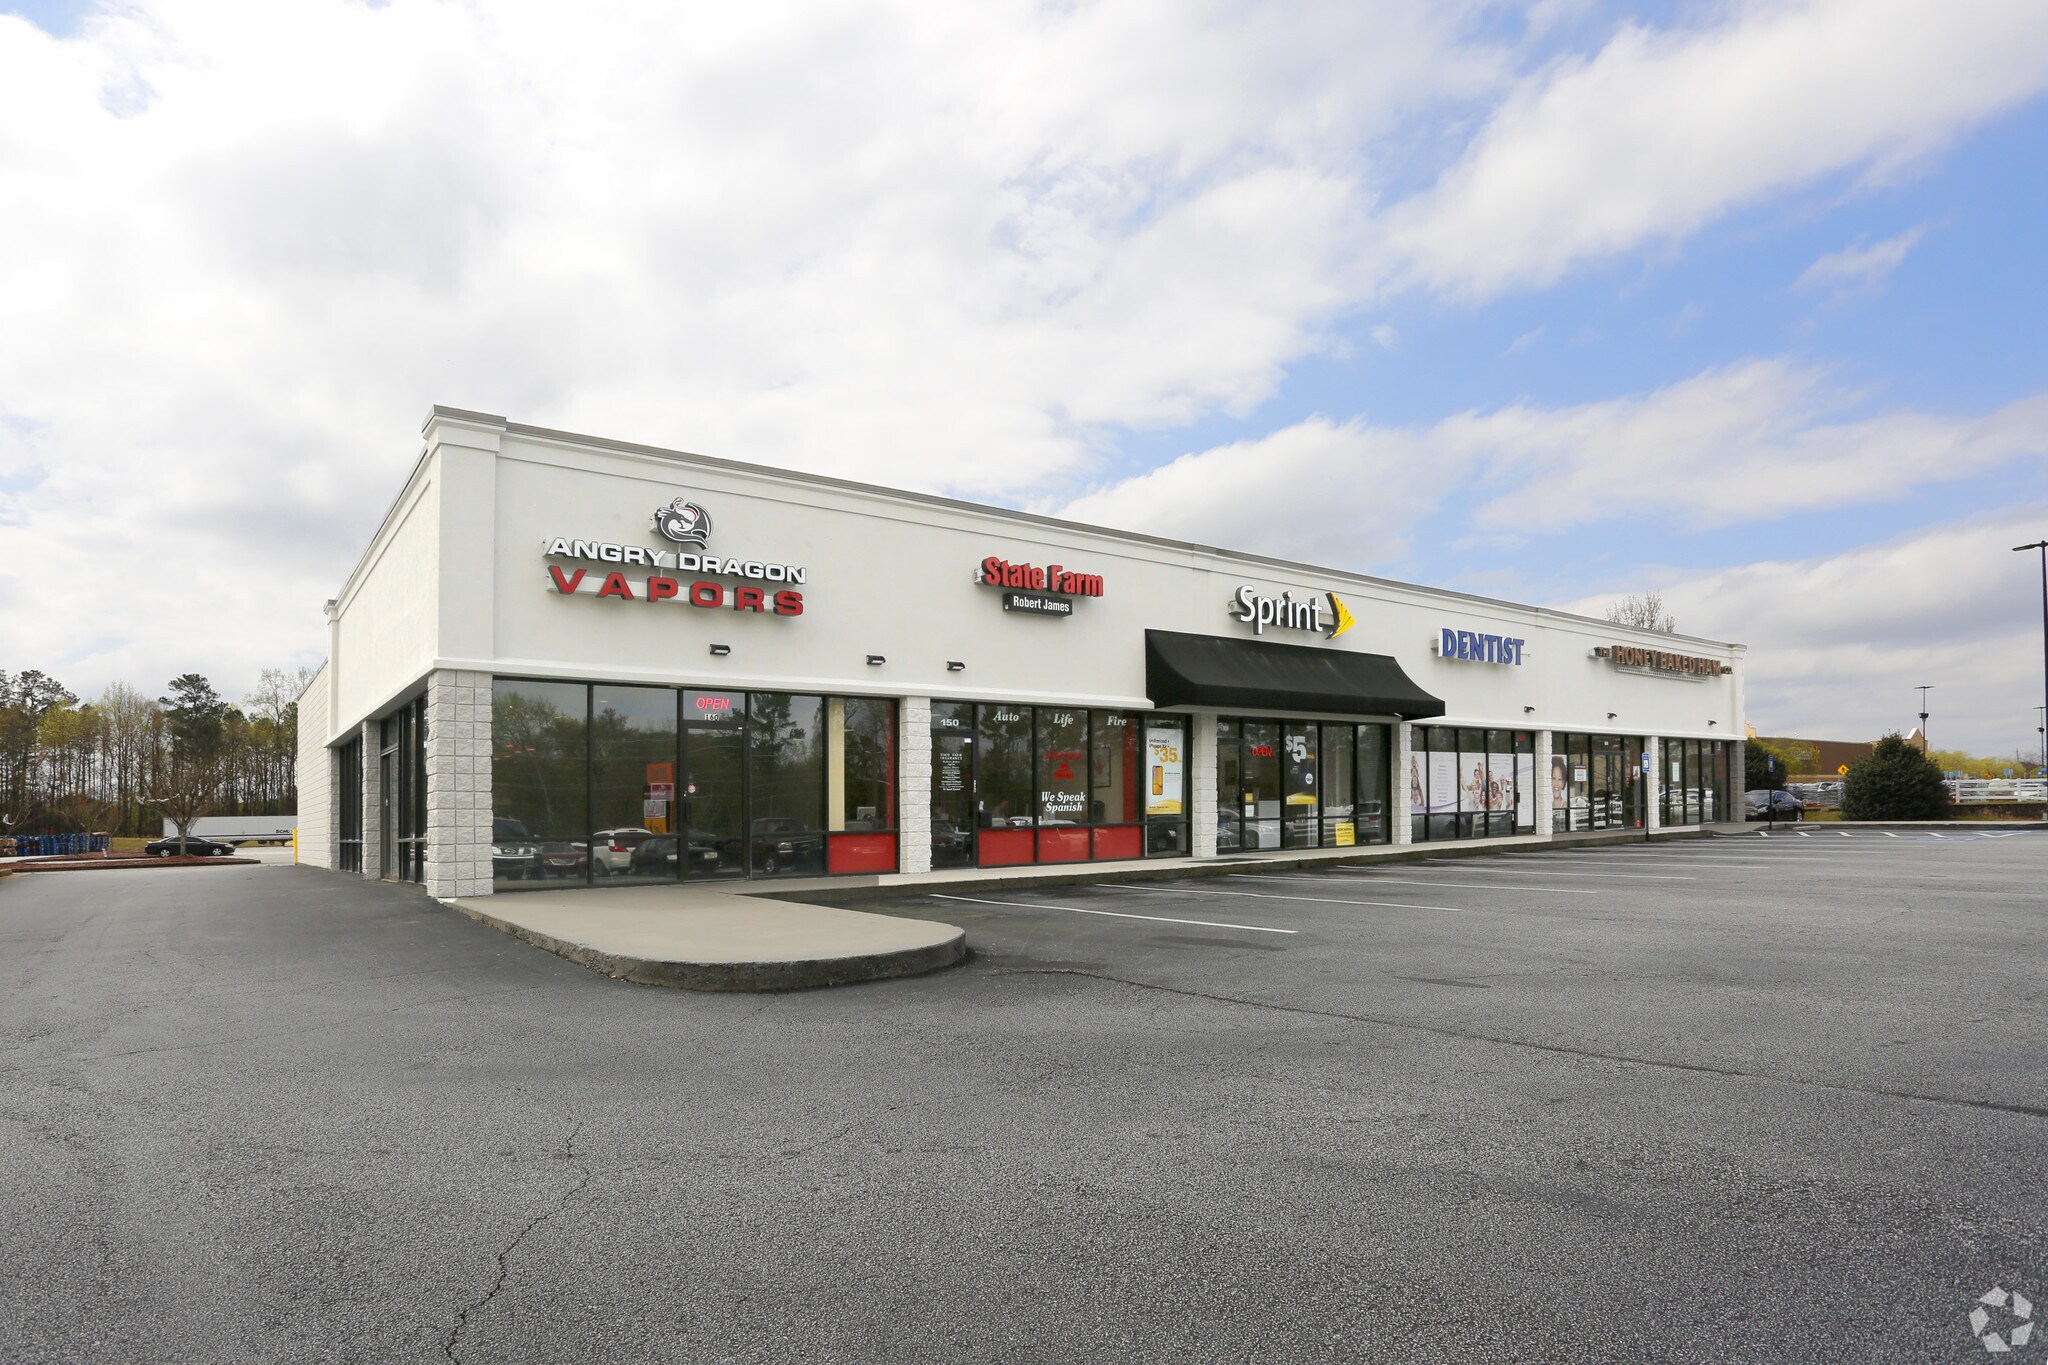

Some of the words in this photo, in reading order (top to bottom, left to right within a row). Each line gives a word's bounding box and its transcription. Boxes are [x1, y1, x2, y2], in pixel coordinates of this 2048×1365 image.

[546, 537, 667, 567] ANGRY
[677, 552, 806, 584] DRAGON
[982, 556, 1044, 590] State
[1047, 565, 1104, 597] Farm
[548, 565, 804, 616] VAPORS
[1013, 595, 1041, 609] Robert
[1043, 599, 1070, 612] James
[1236, 585, 1323, 635] Sprint
[1439, 628, 1525, 666] DENTIST
[1697, 658, 1721, 677] HAM
[696, 697, 730, 710] OPEN
[941, 718, 959, 727] 150
[993, 711, 1019, 721] Auto
[1053, 713, 1074, 727] Life
[1107, 716, 1127, 726] Fire
[1251, 745, 1272, 757] OPEN
[1285, 733, 1307, 763] $5
[1041, 792, 1056, 802] We
[1057, 791, 1086, 803] Speak
[1045, 802, 1082, 813] Spanish
